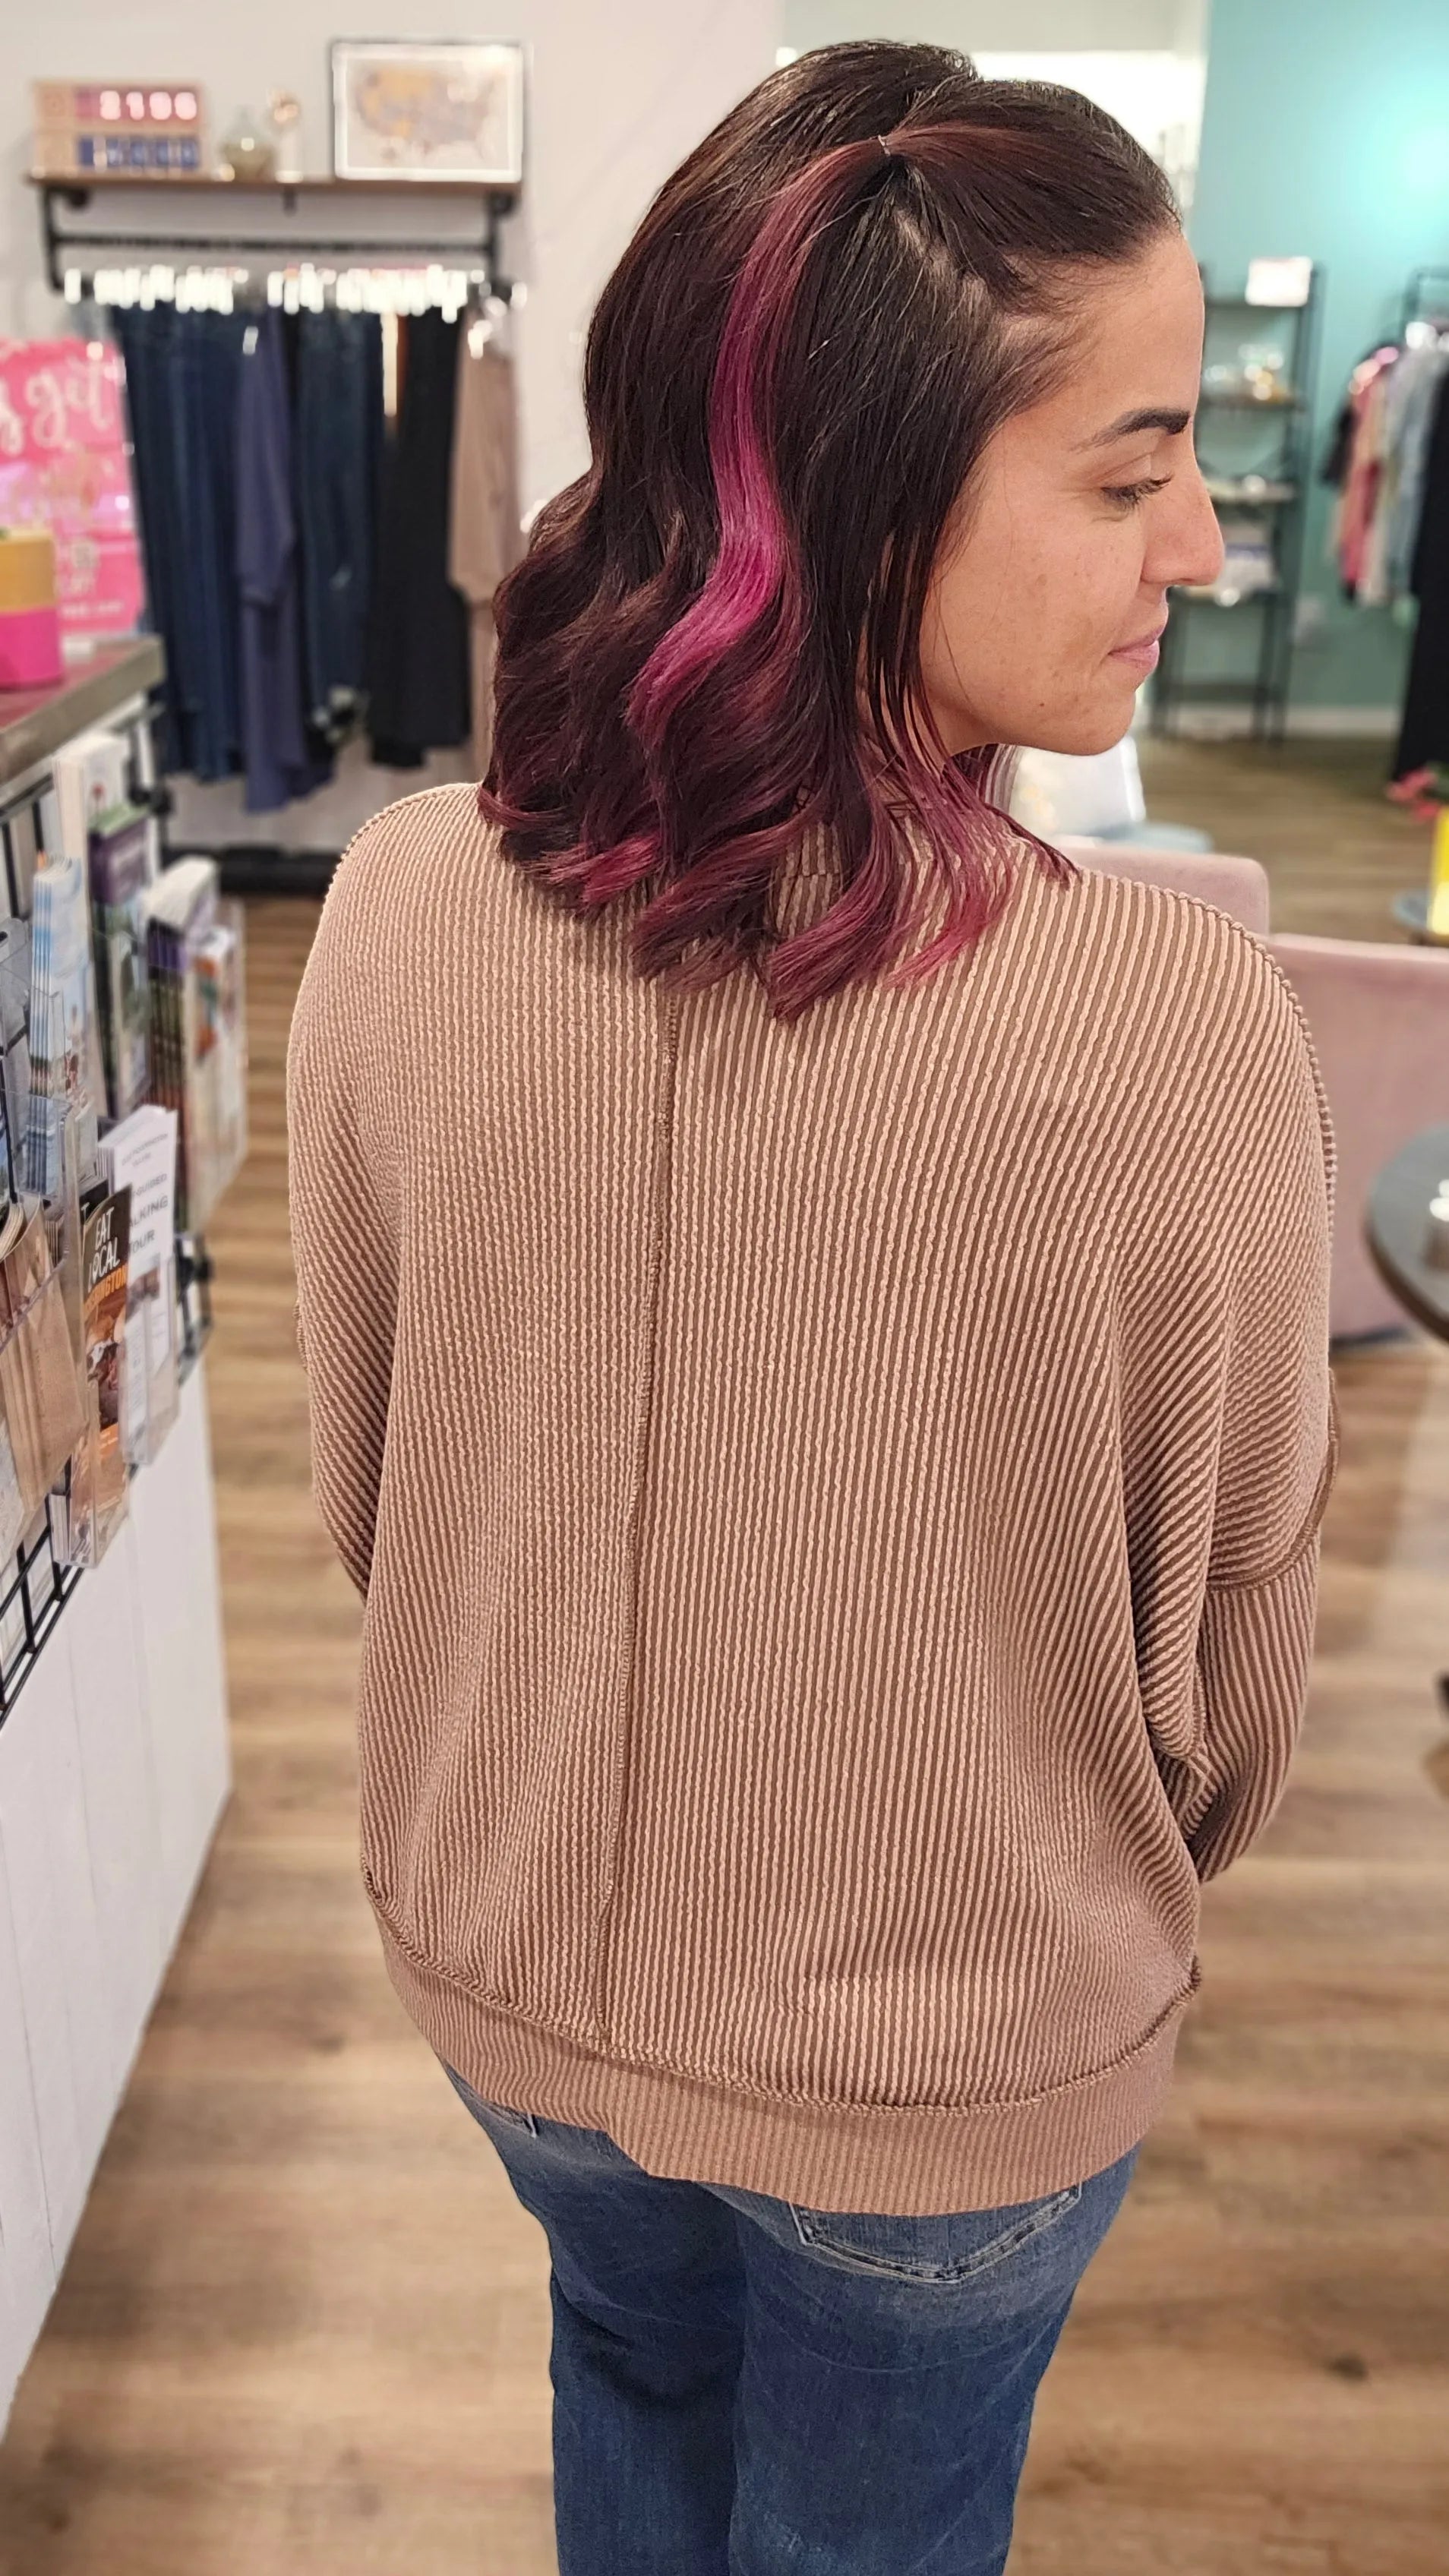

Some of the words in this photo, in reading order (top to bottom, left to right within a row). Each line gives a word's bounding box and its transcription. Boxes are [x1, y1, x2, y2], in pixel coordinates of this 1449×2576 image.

[95, 1206, 115, 1251] EAT
[128, 1195, 168, 1228] ALKING
[87, 1236, 121, 1293] LOCAL
